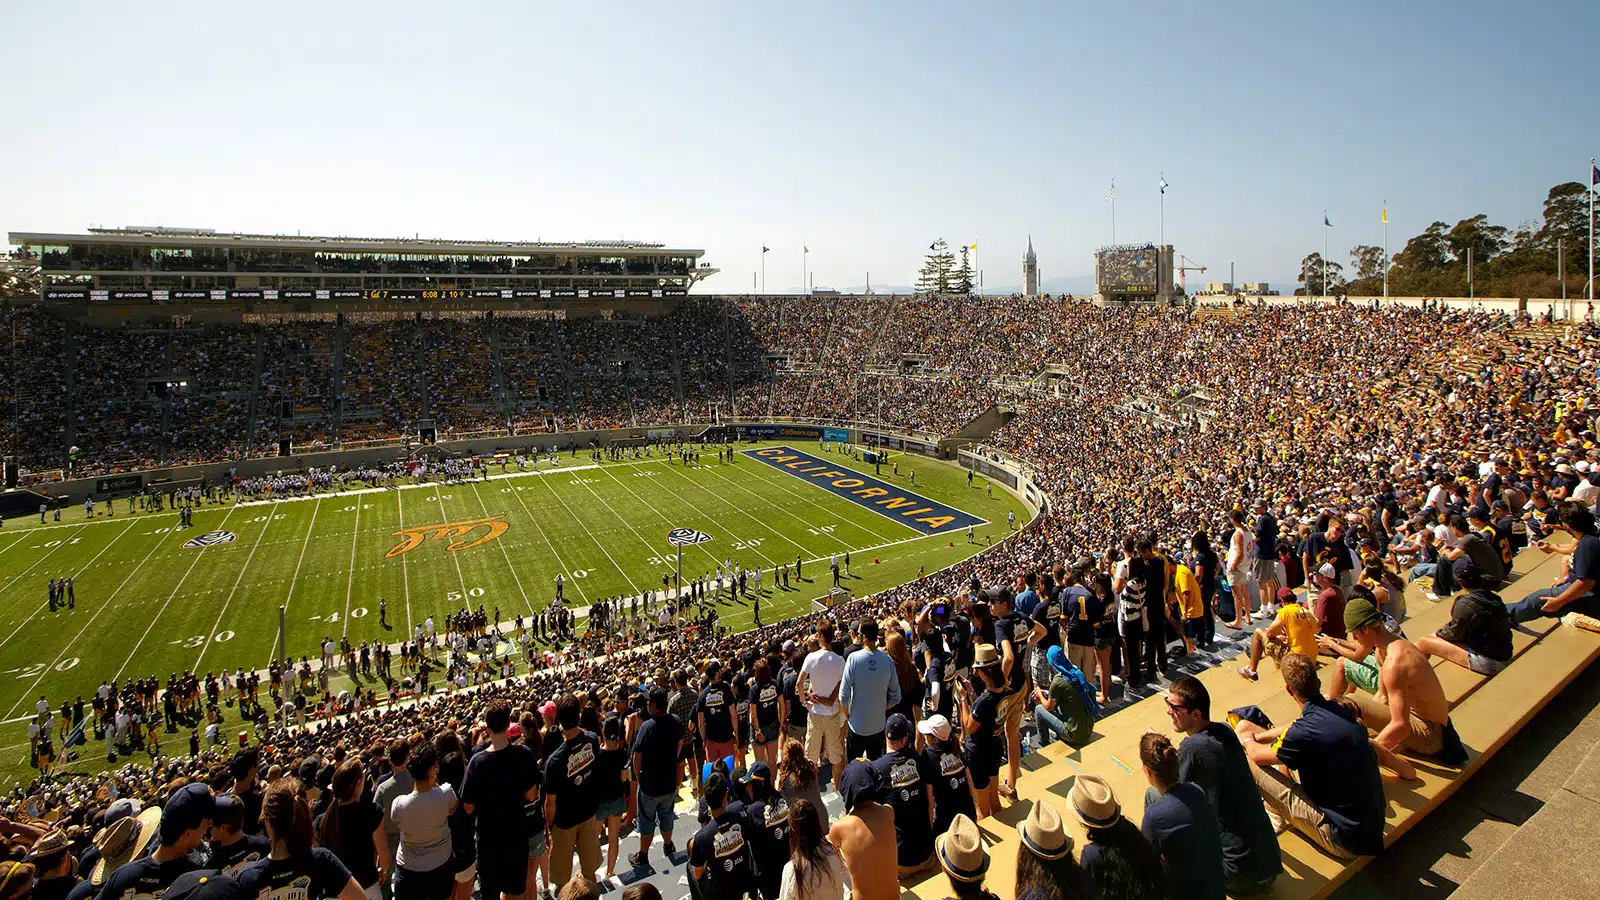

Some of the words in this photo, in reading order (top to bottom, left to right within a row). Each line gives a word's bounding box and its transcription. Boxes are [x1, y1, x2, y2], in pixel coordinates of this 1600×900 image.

[780, 428, 819, 437] CalBears.com
[756, 448, 956, 529] CALIFORNIA
[730, 539, 761, 550] 20
[646, 553, 679, 565] 30
[447, 587, 485, 601] 50
[323, 607, 369, 623] 40
[1078, 596, 1089, 621] 1
[183, 630, 235, 648] 30
[16, 657, 80, 679] 20
